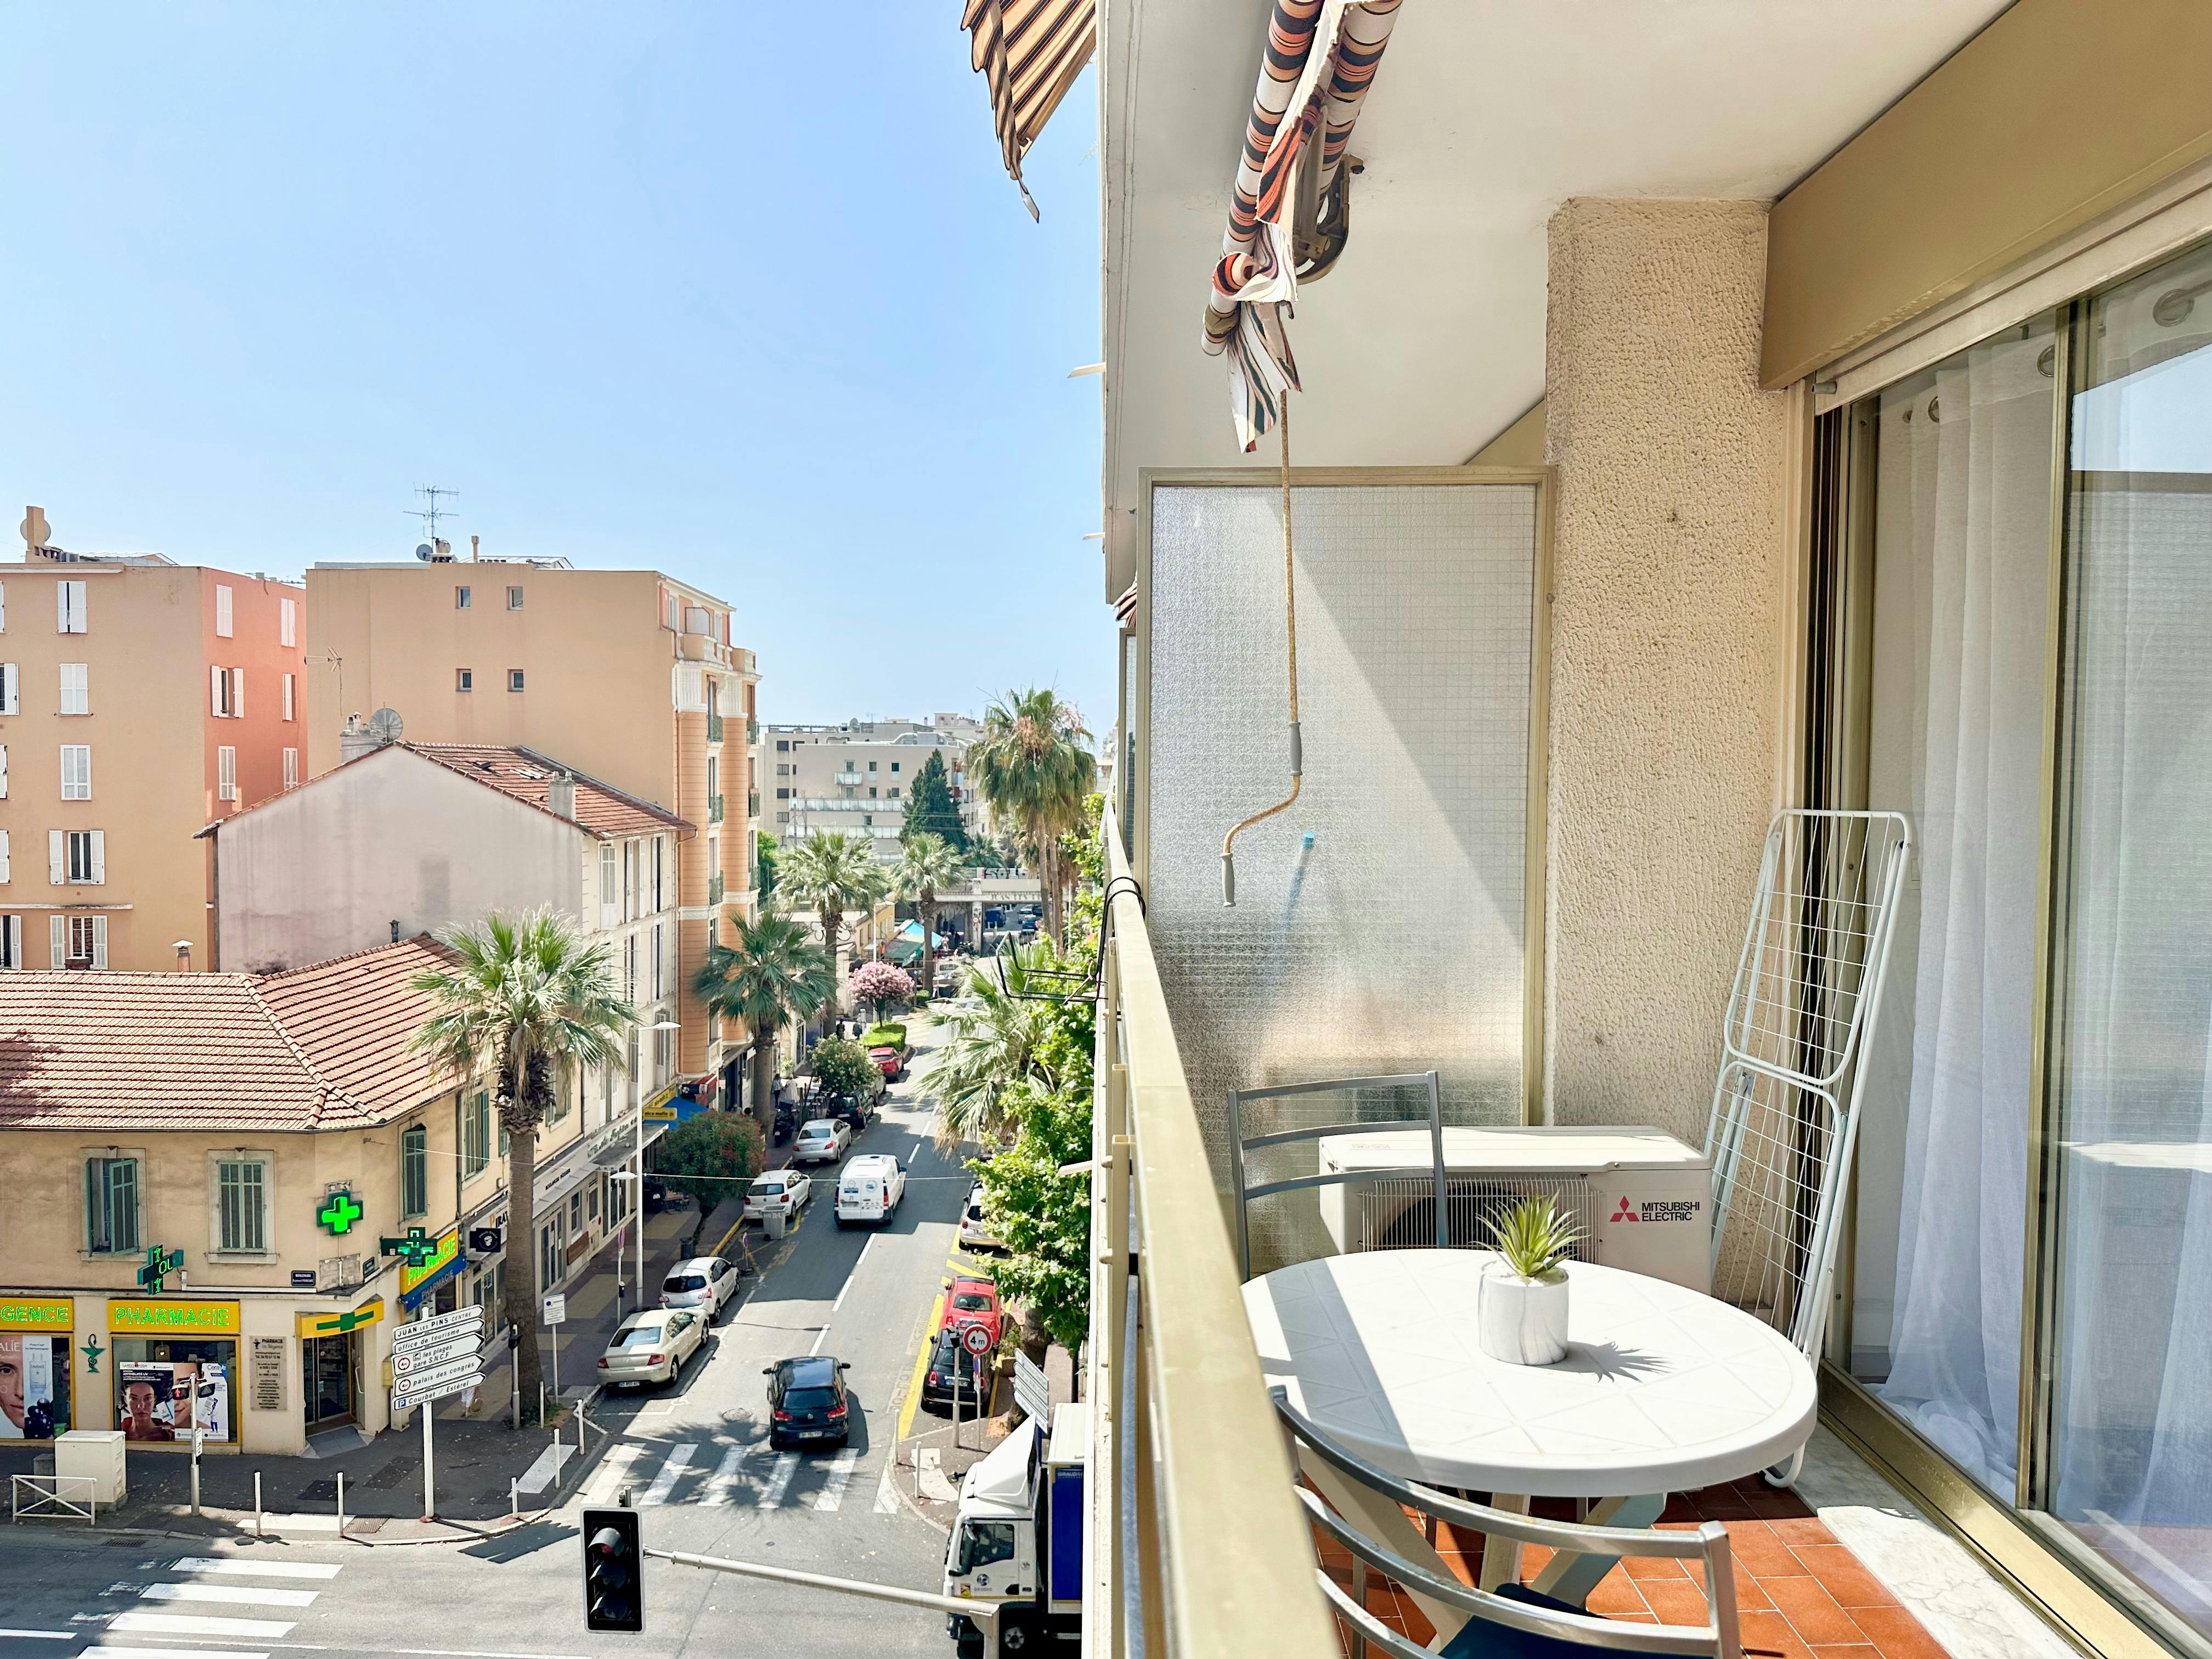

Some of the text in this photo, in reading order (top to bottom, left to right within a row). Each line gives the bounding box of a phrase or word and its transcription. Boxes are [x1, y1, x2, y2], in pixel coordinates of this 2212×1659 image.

[1642, 1201, 1700, 1211] MITSUBISHI
[1642, 1212, 1692, 1221] ELECTRIC
[408, 1237, 456, 1286] PHARMACIE
[421, 1269, 454, 1300] PHARMACIE
[1, 1306, 69, 1322] GENCE
[115, 1307, 229, 1325] PHARMACIE
[398, 1327, 417, 1337] JUAN
[431, 1318, 448, 1327] PINS
[452, 1312, 471, 1322] CENTRE
[398, 1342, 417, 1351] office
[431, 1329, 460, 1341] tourisme
[970, 1336, 976, 1344] 4
[433, 1345, 453, 1355] plages
[413, 1361, 426, 1369] gare
[413, 1376, 433, 1386] palais
[409, 1392, 435, 1404] Courbet
[447, 1380, 469, 1392] Estérel
